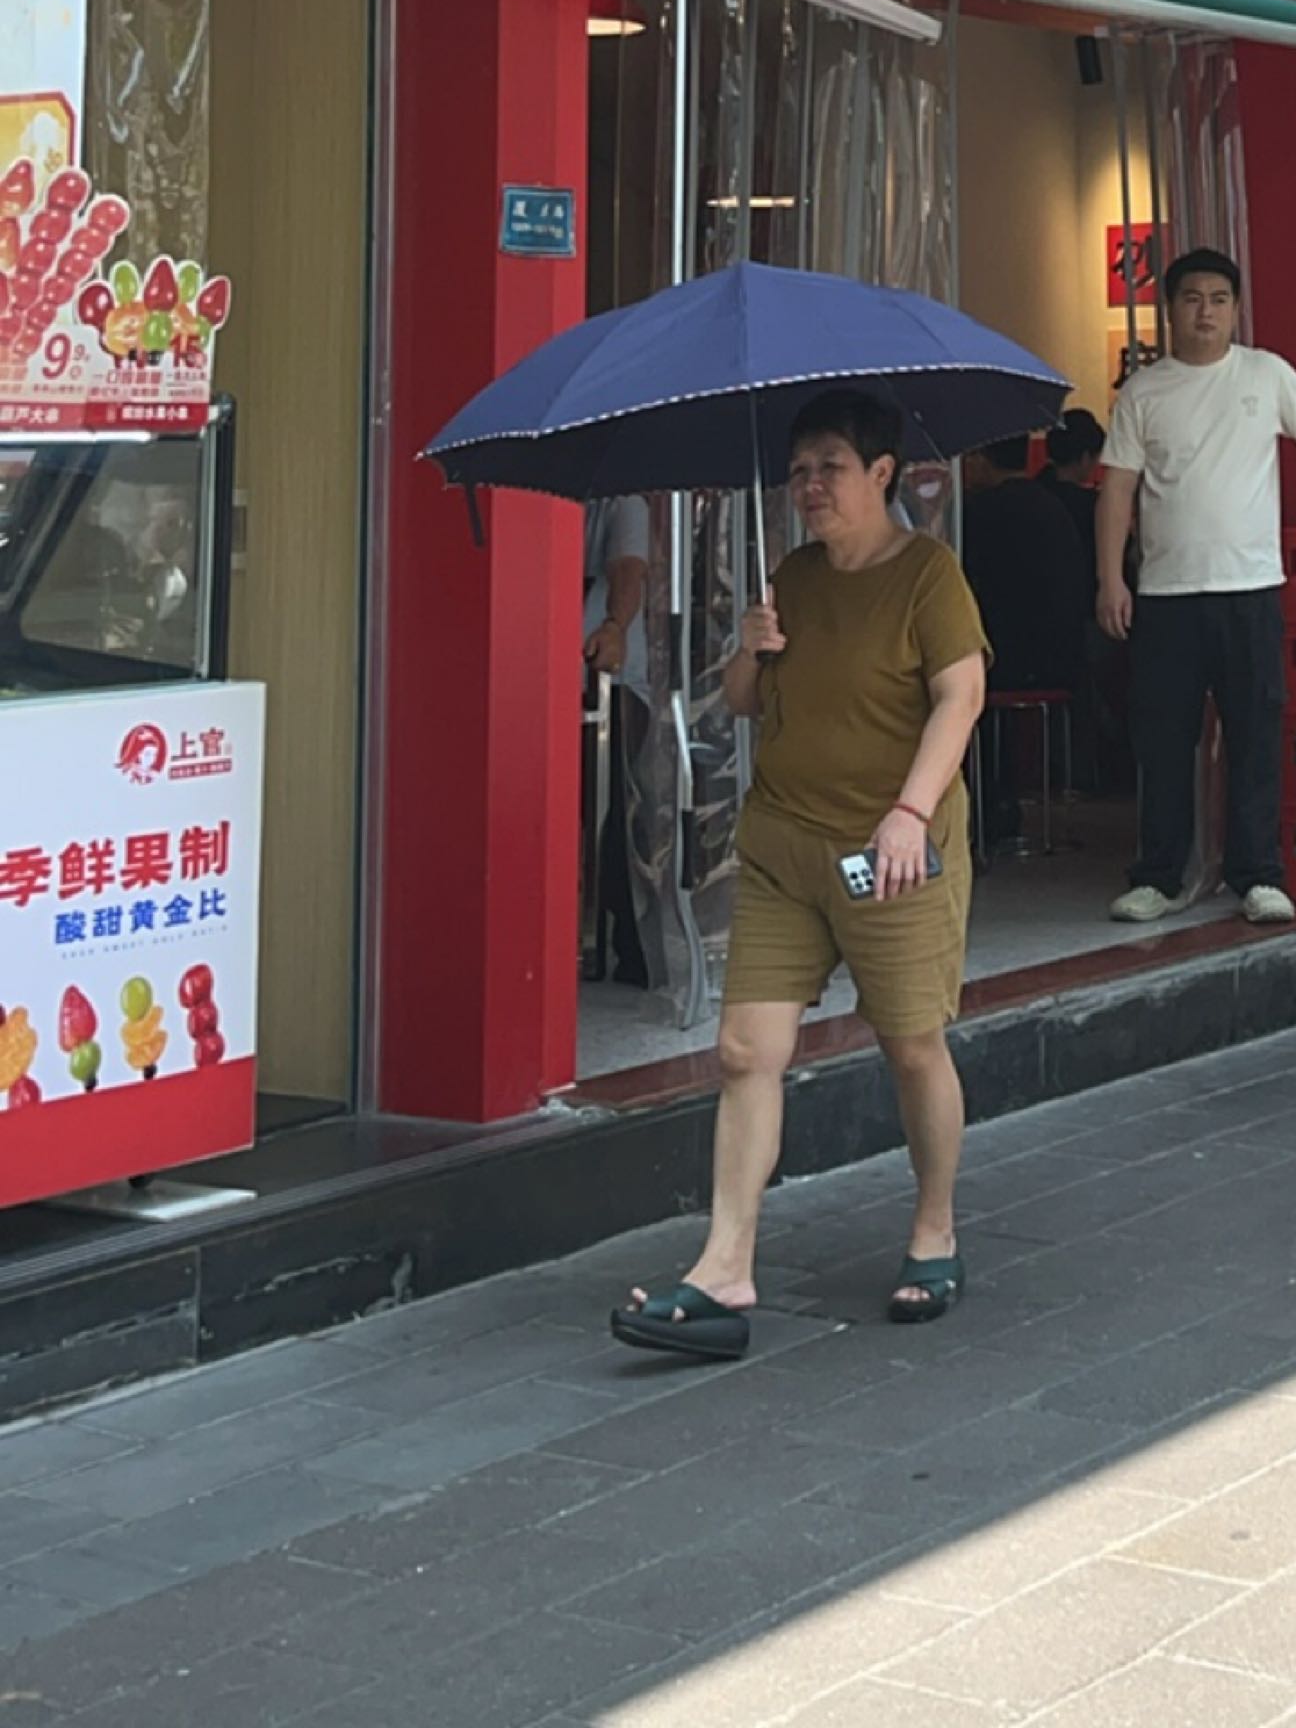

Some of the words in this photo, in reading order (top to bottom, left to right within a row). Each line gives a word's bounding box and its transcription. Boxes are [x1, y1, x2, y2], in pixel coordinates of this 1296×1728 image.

[170, 727, 225, 761] 上官
[0, 820, 231, 908] 季鲜果制
[54, 887, 227, 944] 酸甜黄金比
